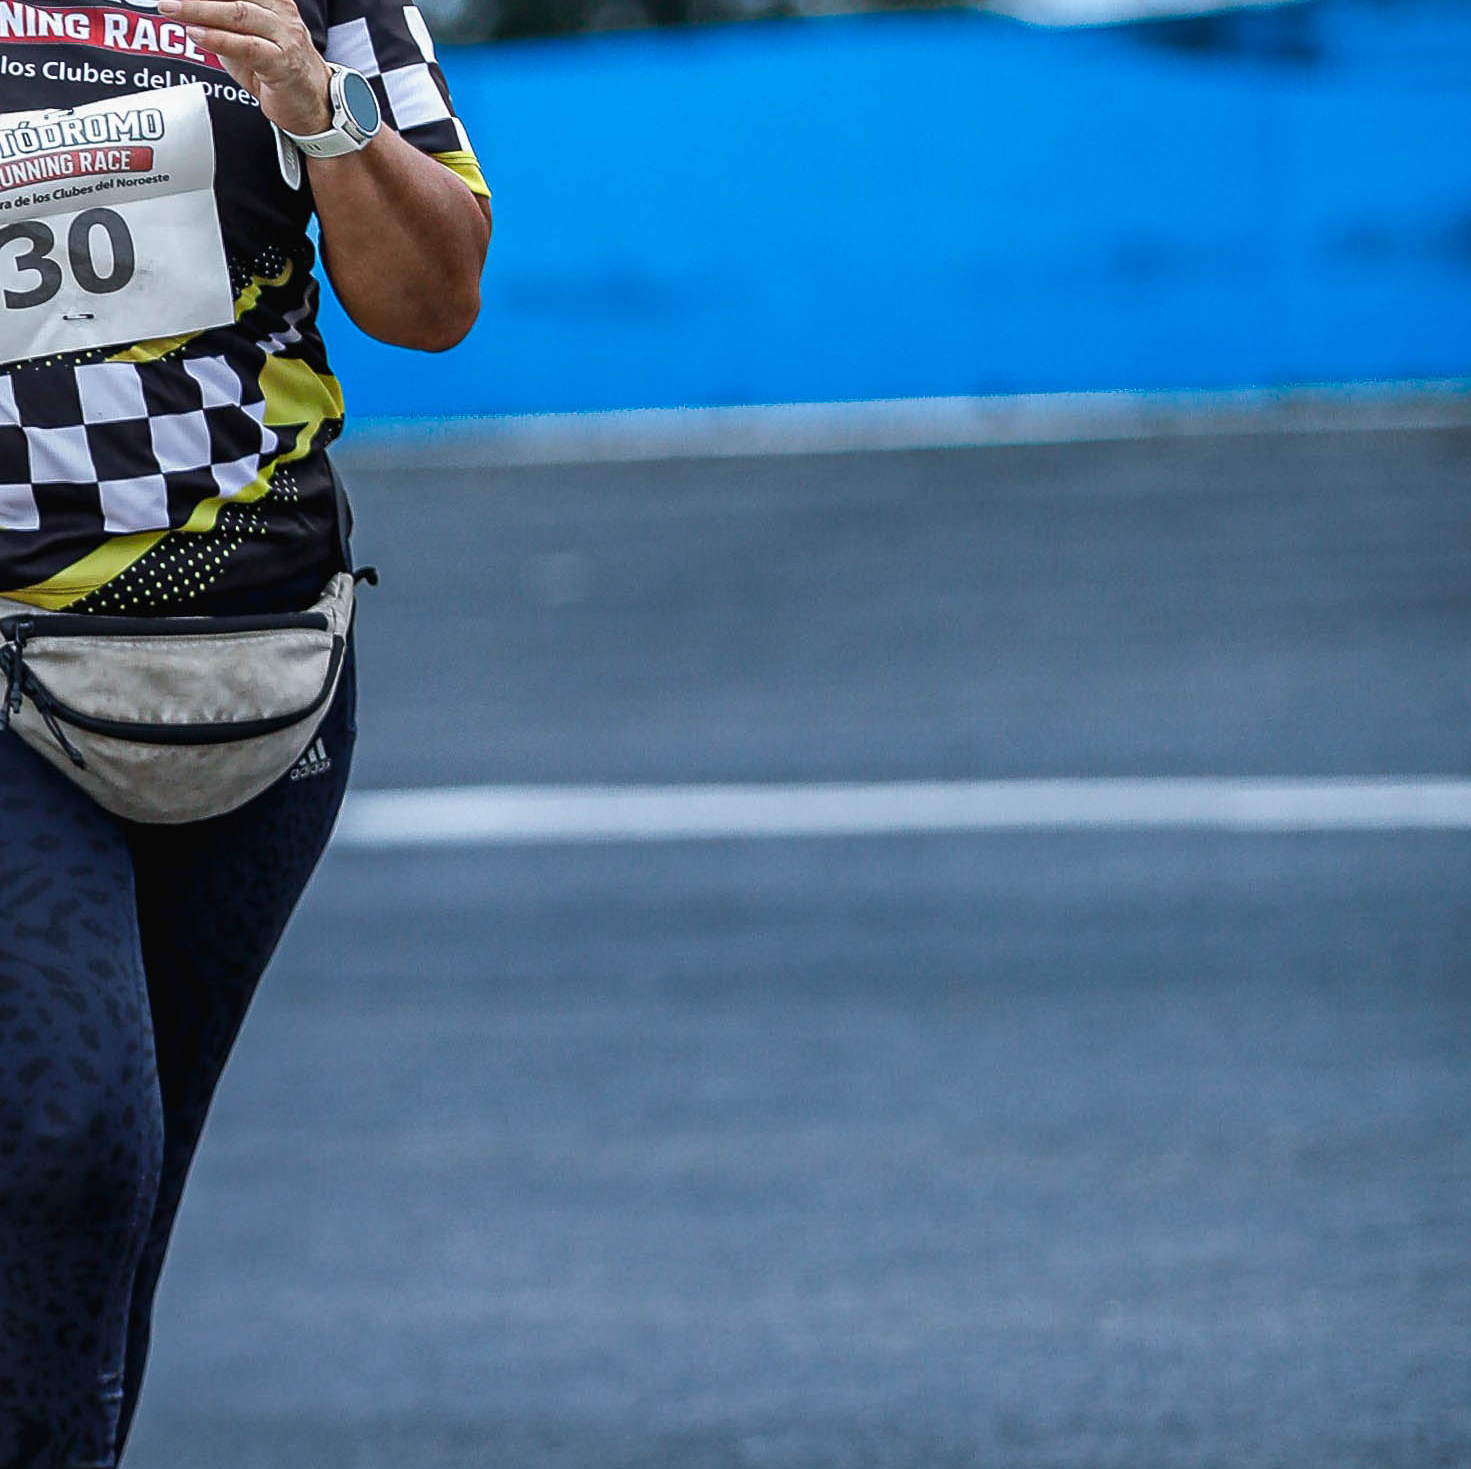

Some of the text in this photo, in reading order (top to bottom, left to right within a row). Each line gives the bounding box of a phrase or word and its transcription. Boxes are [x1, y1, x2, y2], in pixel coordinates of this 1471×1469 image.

[2, 56, 36, 77] los
[42, 61, 126, 85] Clubes
[133, 68, 173, 89] del
[80, 150, 130, 172] RACE
[15, 196, 29, 207] de
[33, 192, 50, 205] los
[53, 186, 92, 200] Clubes
[96, 180, 114, 192] del
[117, 173, 169, 189] Noroeste
